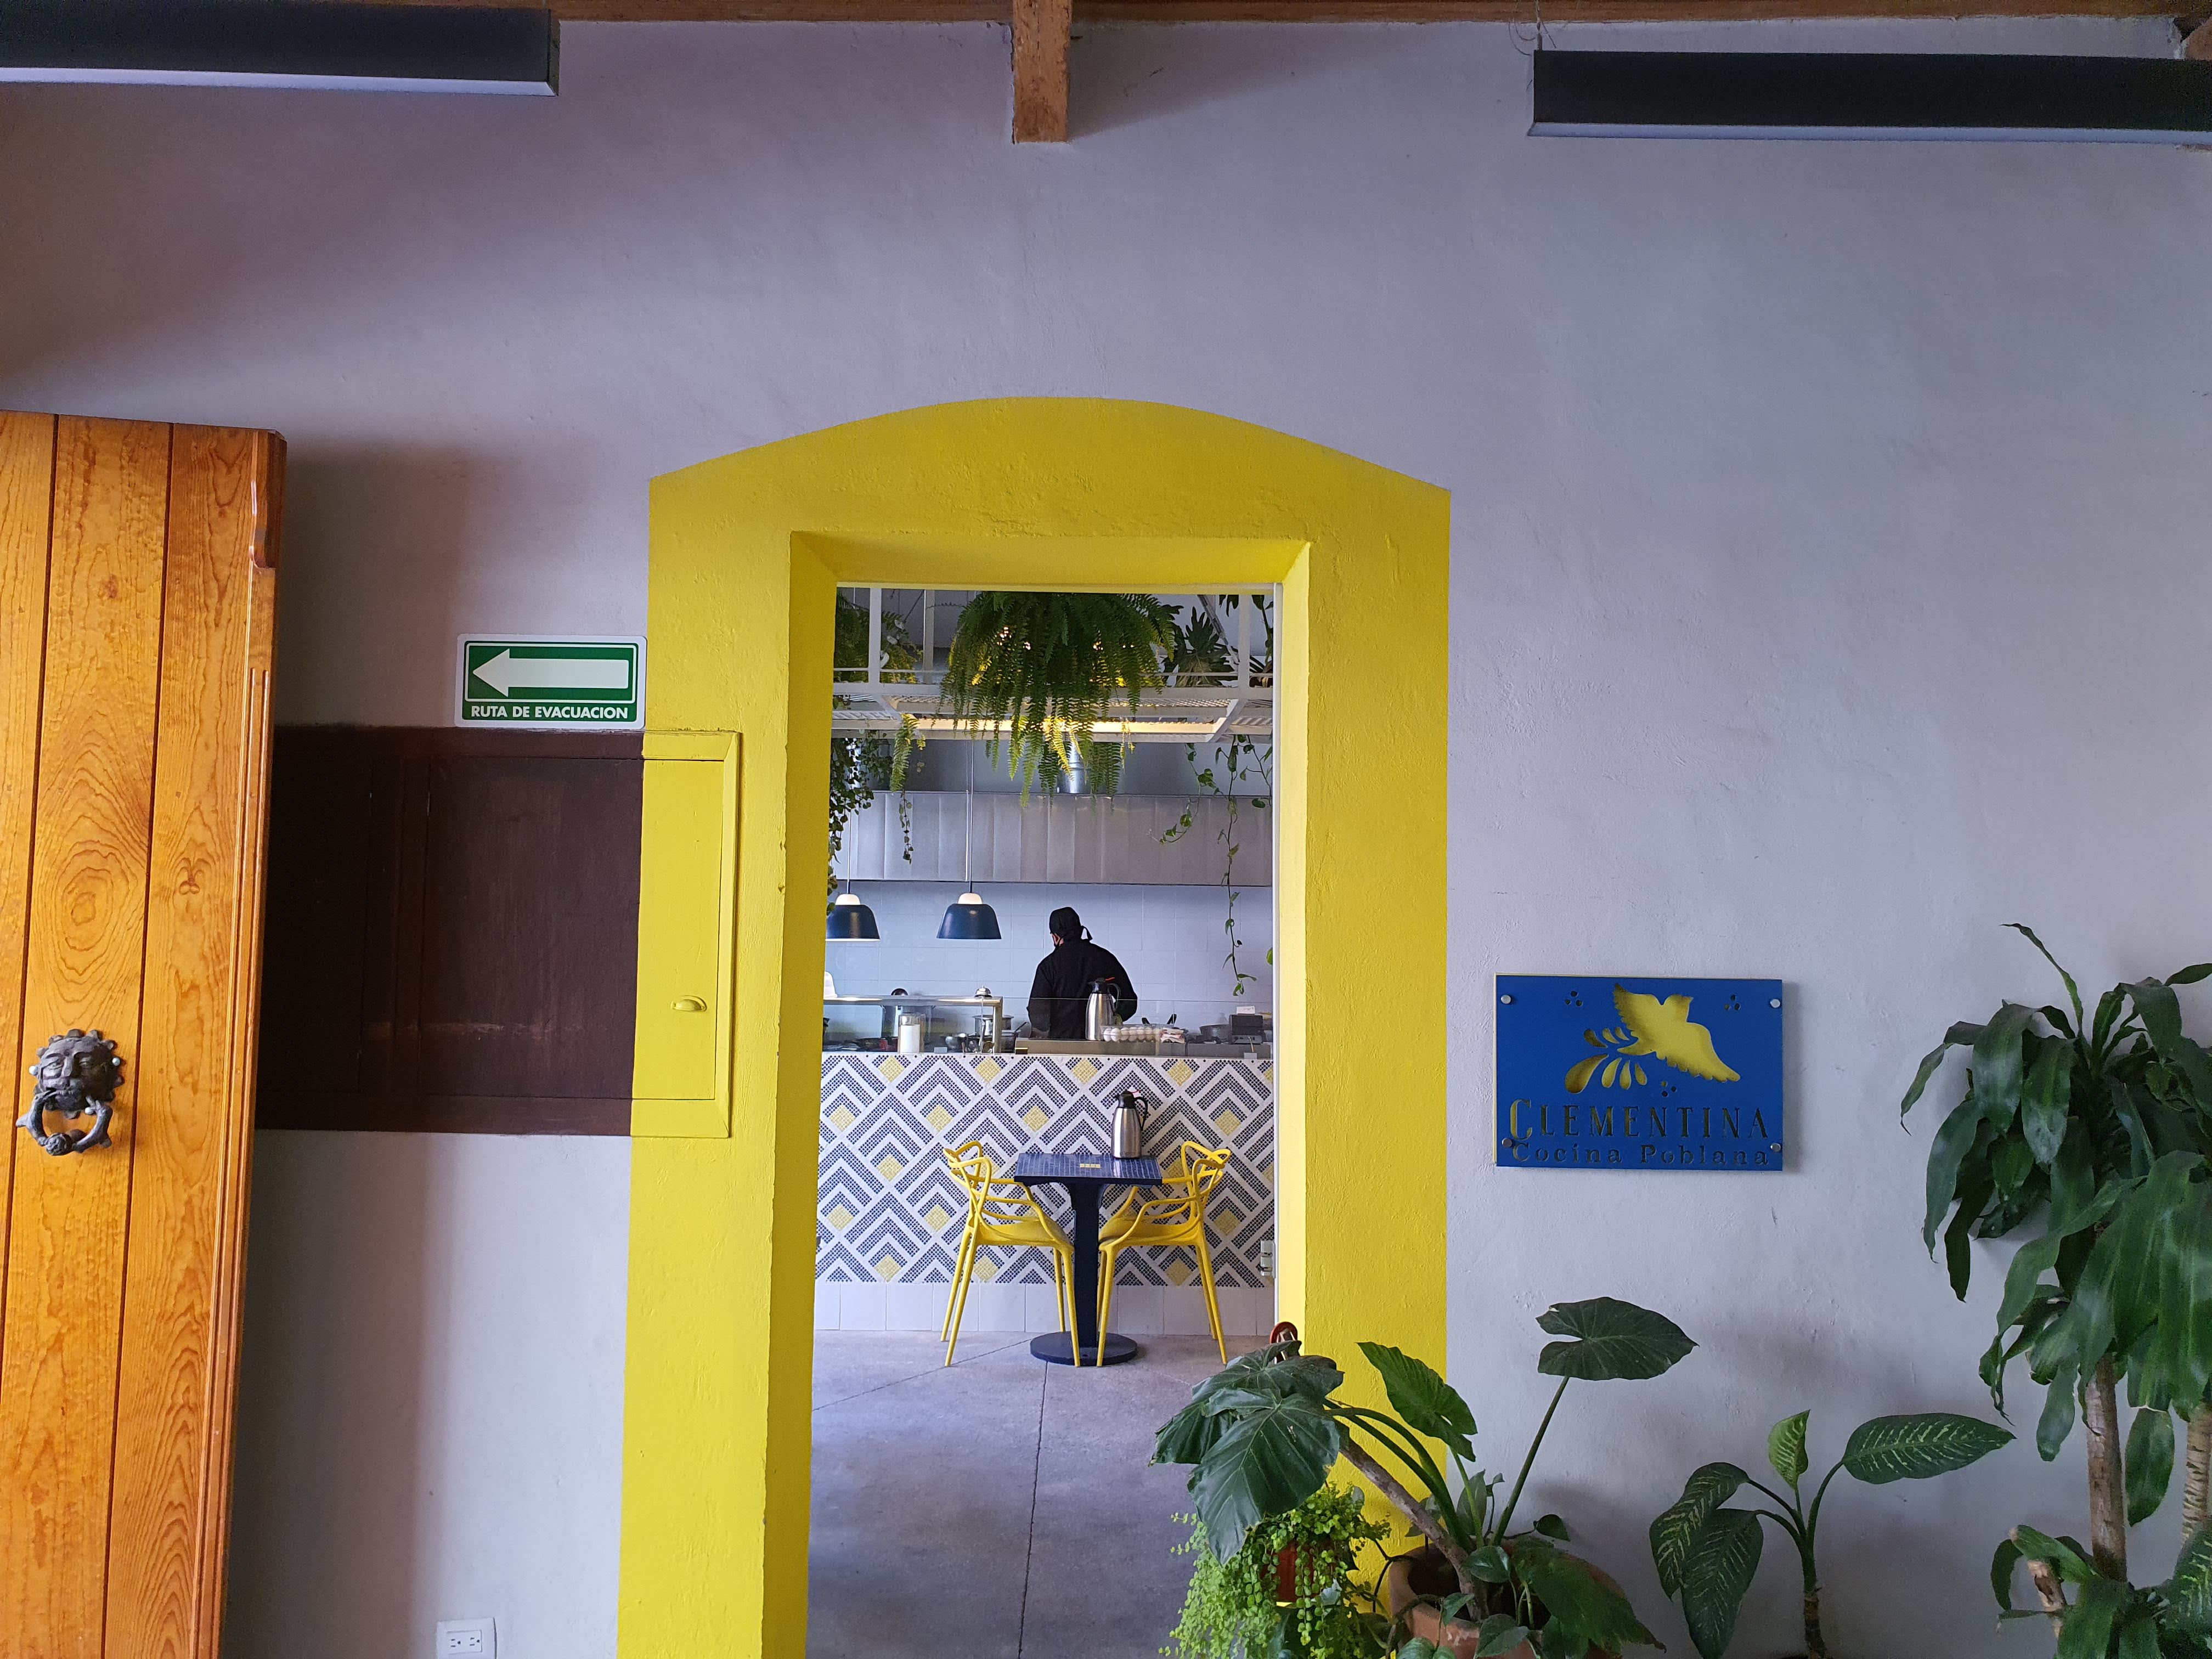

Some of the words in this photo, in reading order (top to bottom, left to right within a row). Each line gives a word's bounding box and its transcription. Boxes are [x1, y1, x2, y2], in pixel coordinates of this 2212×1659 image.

[471, 706, 508, 718] RUTA
[513, 706, 530, 718] DE
[535, 706, 628, 719] EVACUACION
[1510, 1098, 1768, 1141] CLEMENTINA
[1512, 1142, 1622, 1163] Cocina
[1641, 1144, 1769, 1166] Poblana
